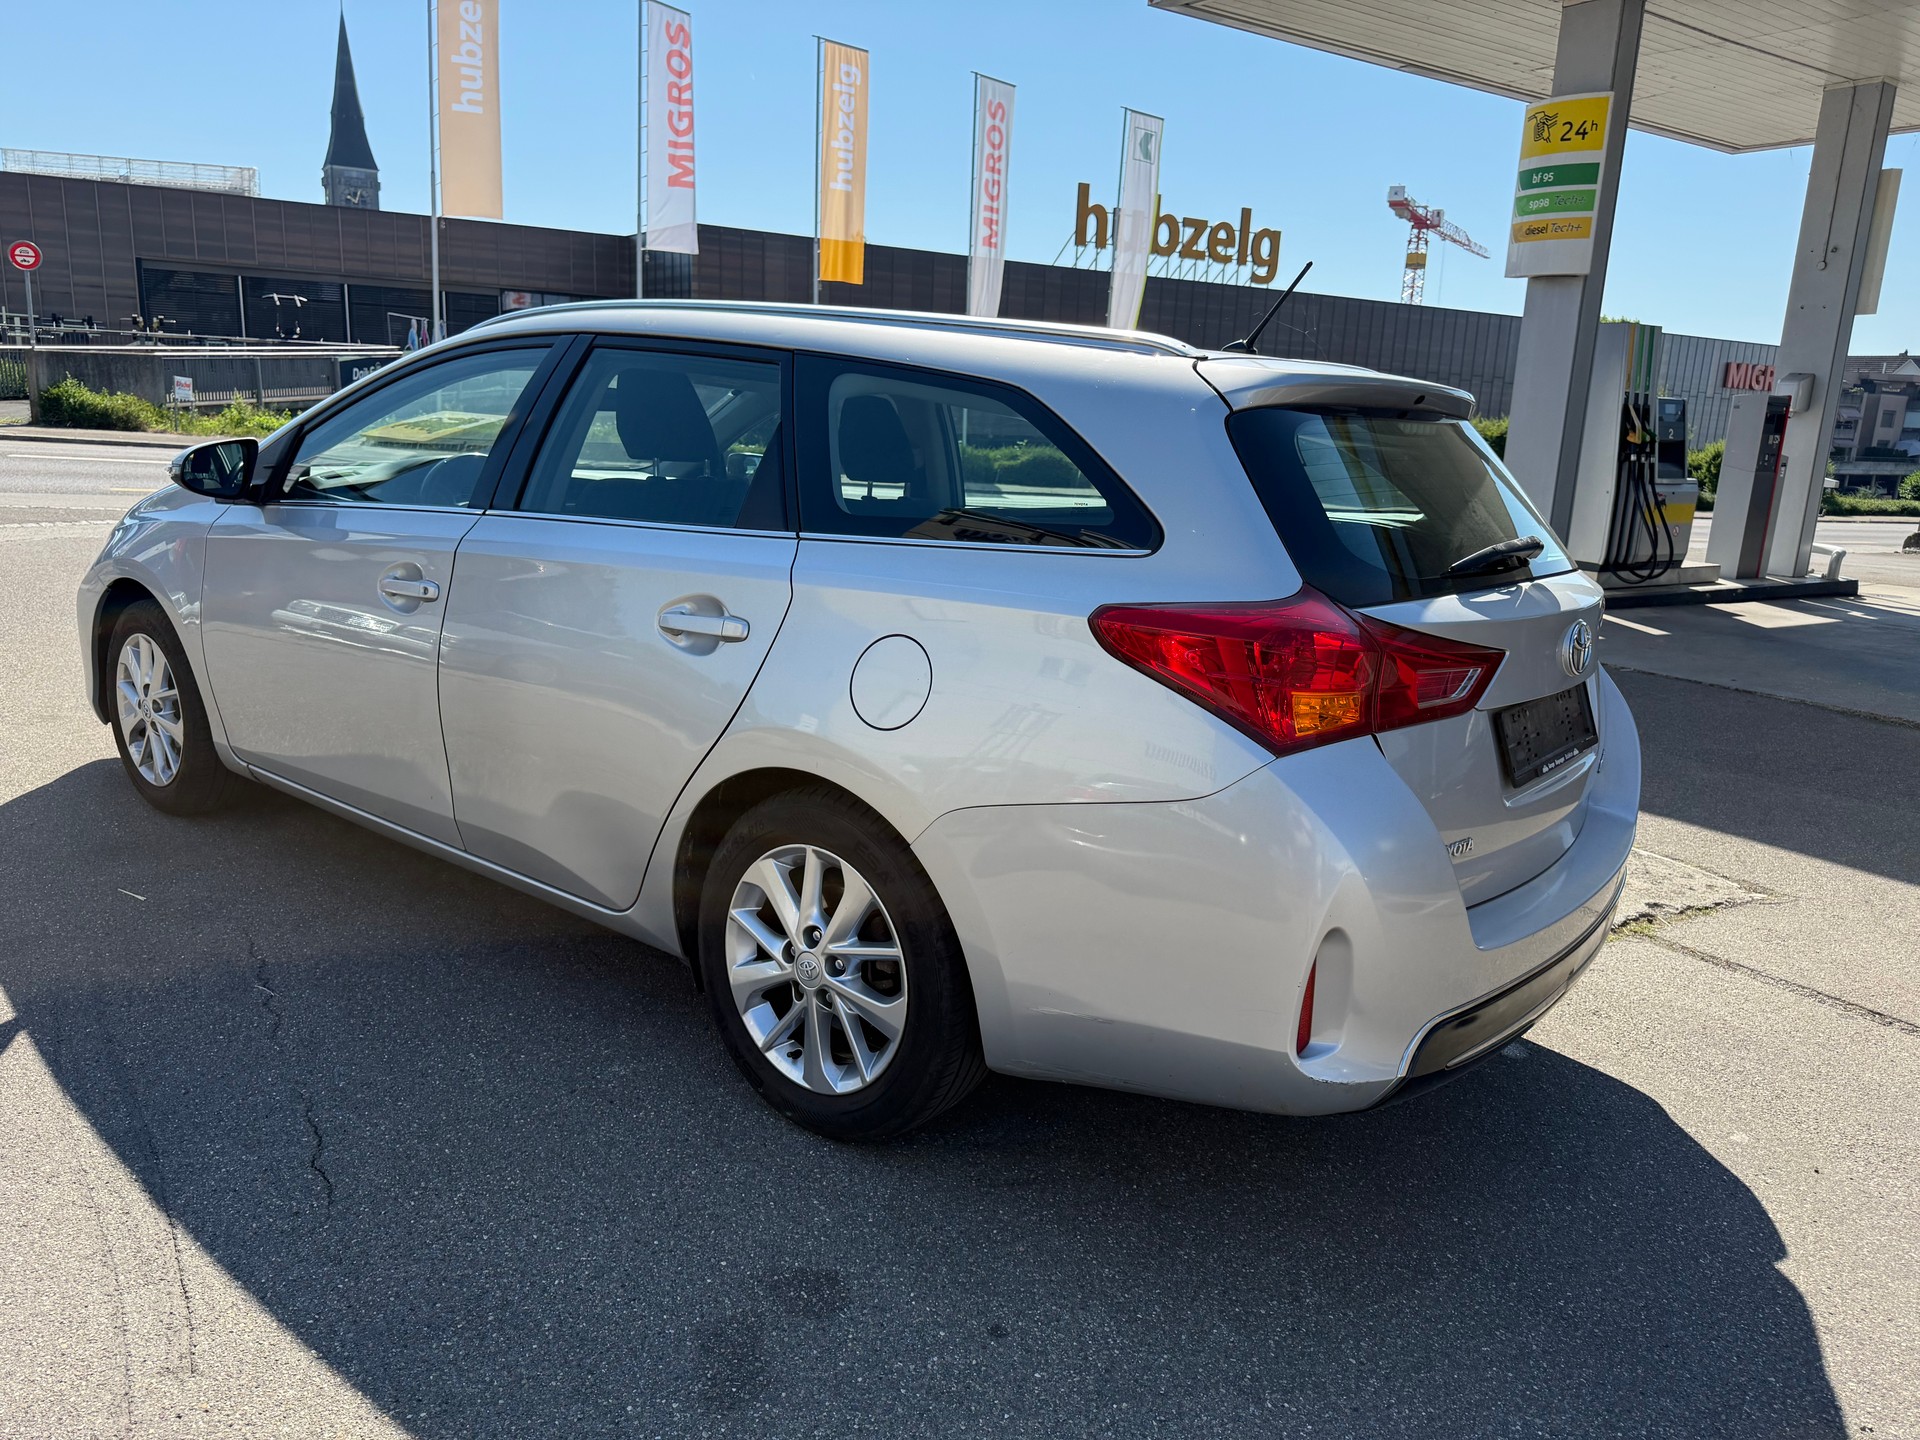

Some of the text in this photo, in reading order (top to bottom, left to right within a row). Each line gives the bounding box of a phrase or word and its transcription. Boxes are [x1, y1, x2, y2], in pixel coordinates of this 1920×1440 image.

[665, 20, 695, 189] MIGROS
[829, 63, 862, 192] hubzelg
[982, 98, 1006, 249] MIGROS
[1528, 195, 1586, 211] sp98 Tech+
[1525, 222, 1582, 236] diesel Tech+
[1668, 428, 1674, 440] 2
